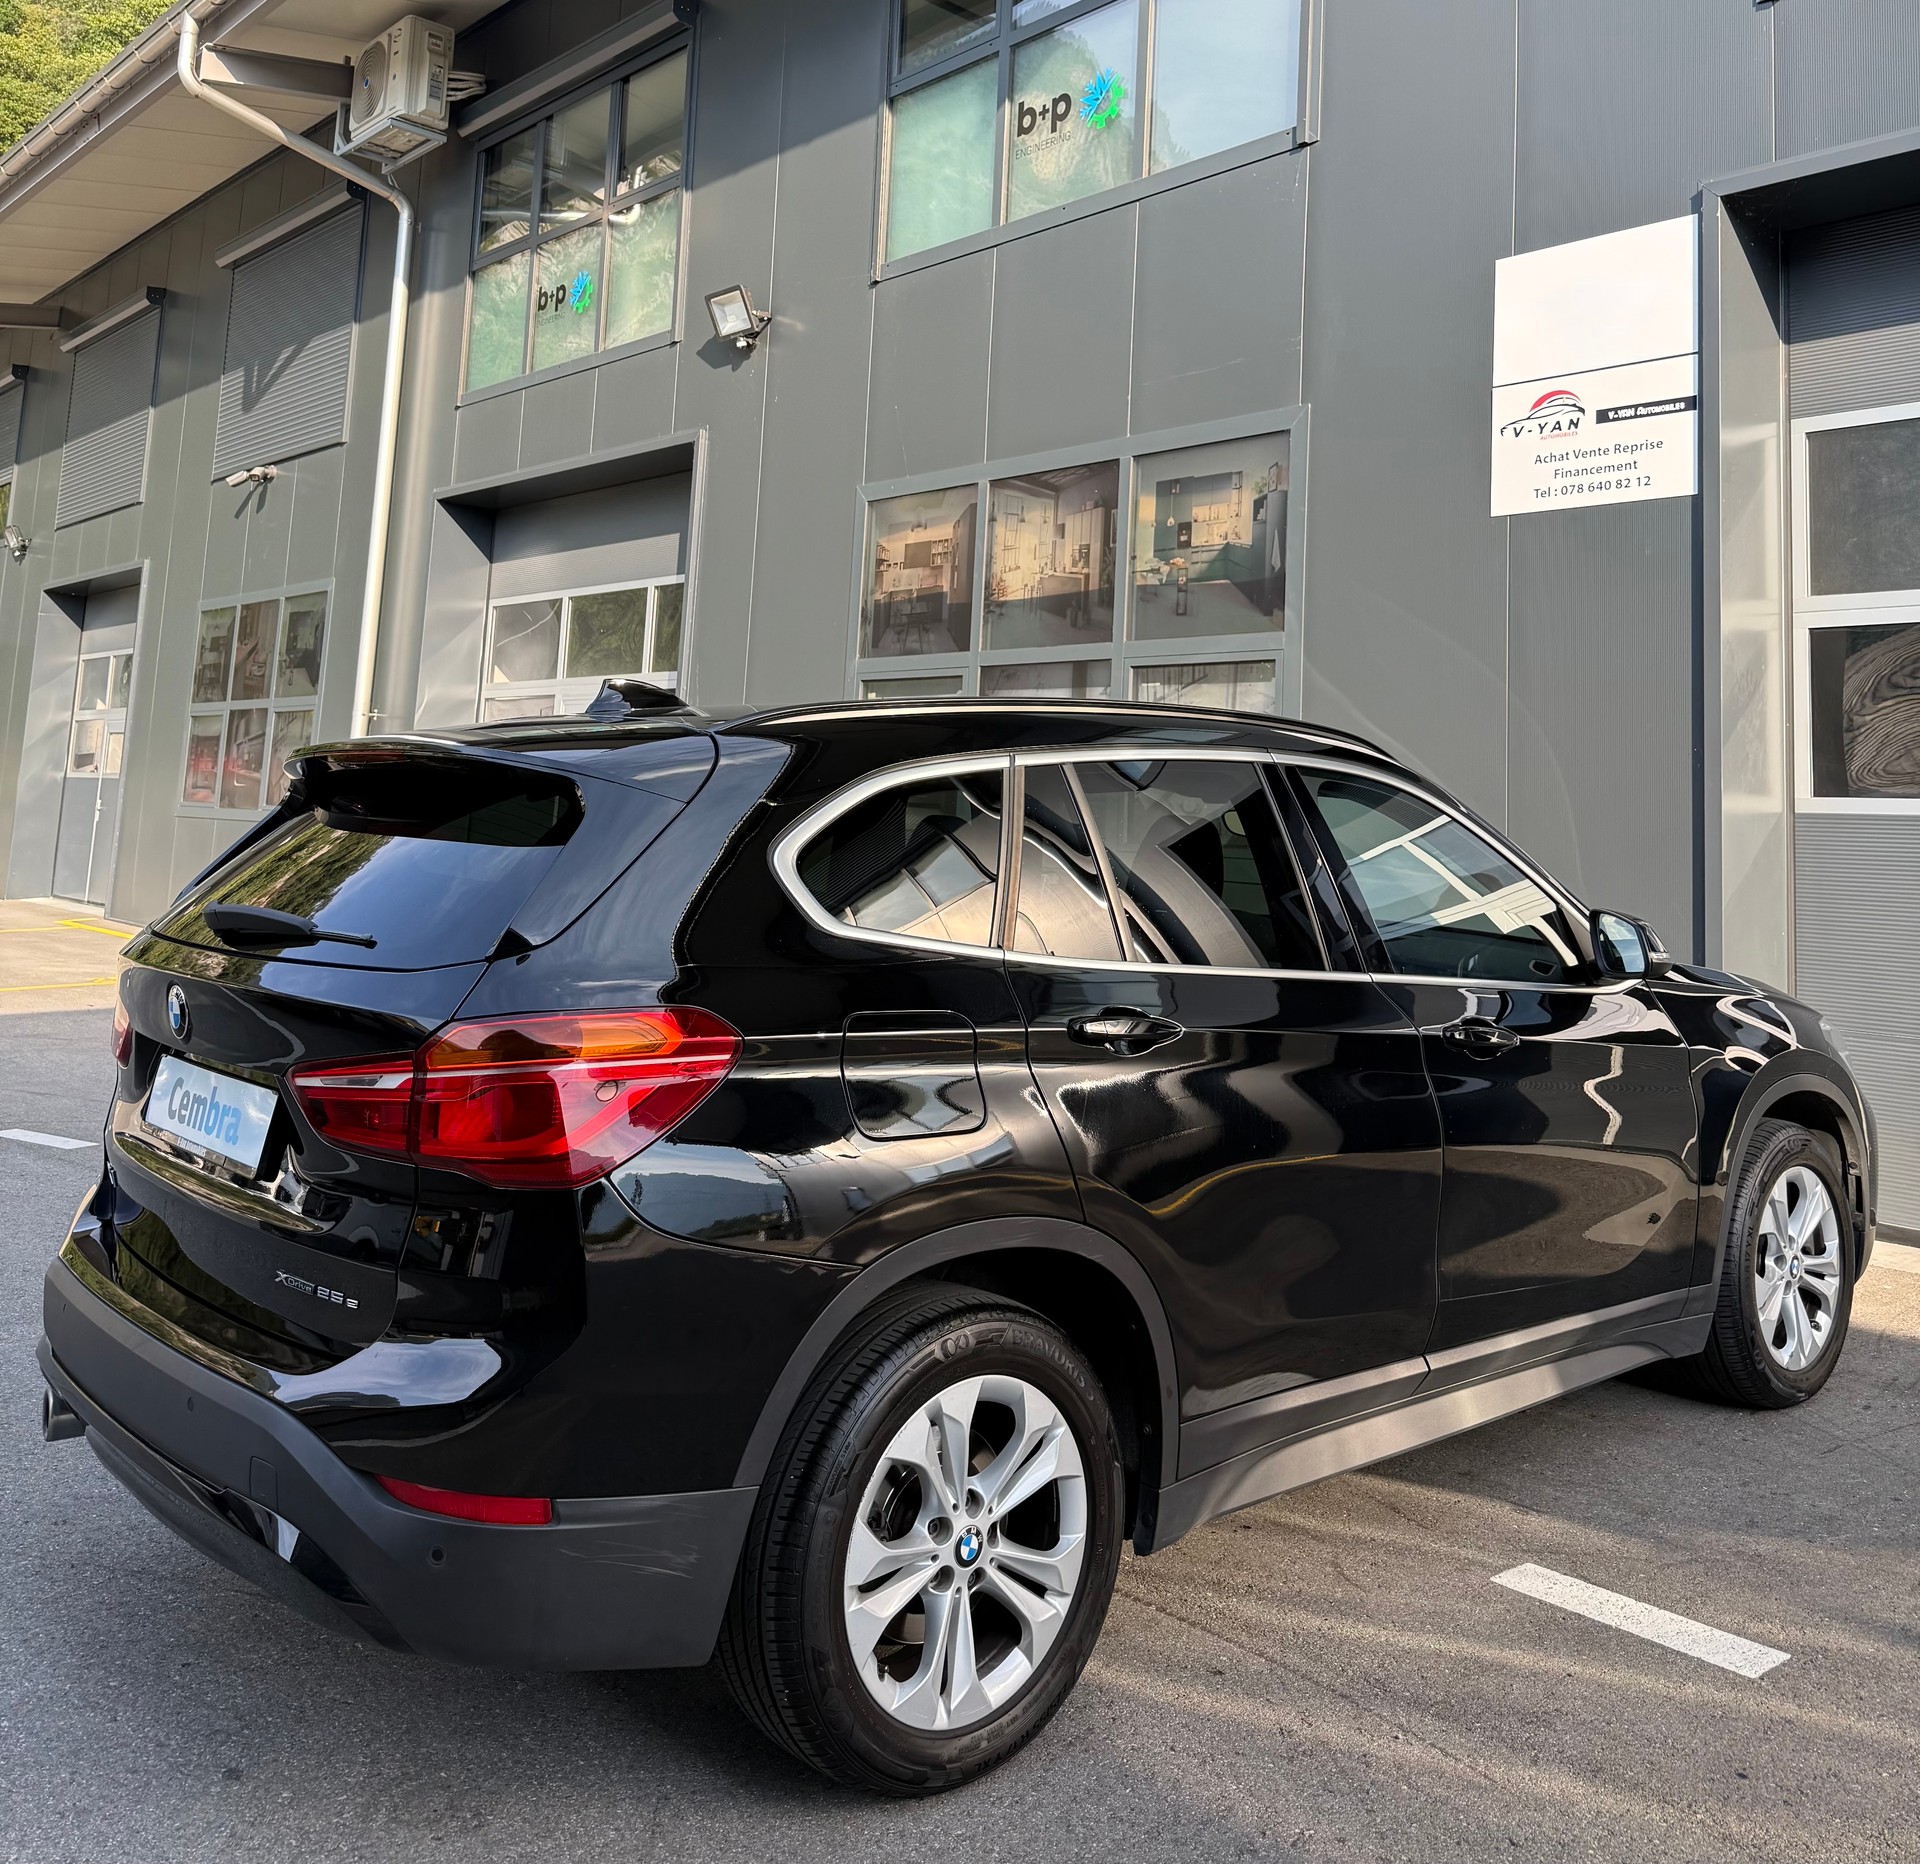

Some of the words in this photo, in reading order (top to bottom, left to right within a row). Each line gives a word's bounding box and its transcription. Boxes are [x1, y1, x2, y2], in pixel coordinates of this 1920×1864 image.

[1016, 93, 1072, 138] b+p
[1015, 130, 1072, 160] ENGINEERING
[537, 284, 567, 312] b+p
[1608, 407, 1635, 420] V-YAN
[1513, 417, 1580, 438] V-YAN
[1539, 431, 1578, 441] AUTOMOBILES
[1534, 451, 1570, 465] Achat
[1573, 447, 1610, 460] Vente
[1613, 438, 1664, 455] Reprise
[1553, 460, 1638, 479] Financement
[1560, 482, 1585, 496] 078
[1588, 480, 1612, 493] 640
[1615, 478, 1632, 489] 82
[1636, 475, 1651, 487] 12
[167, 1076, 242, 1146] Cembra
[1012, 1330, 1086, 1388] BRAVURIS
